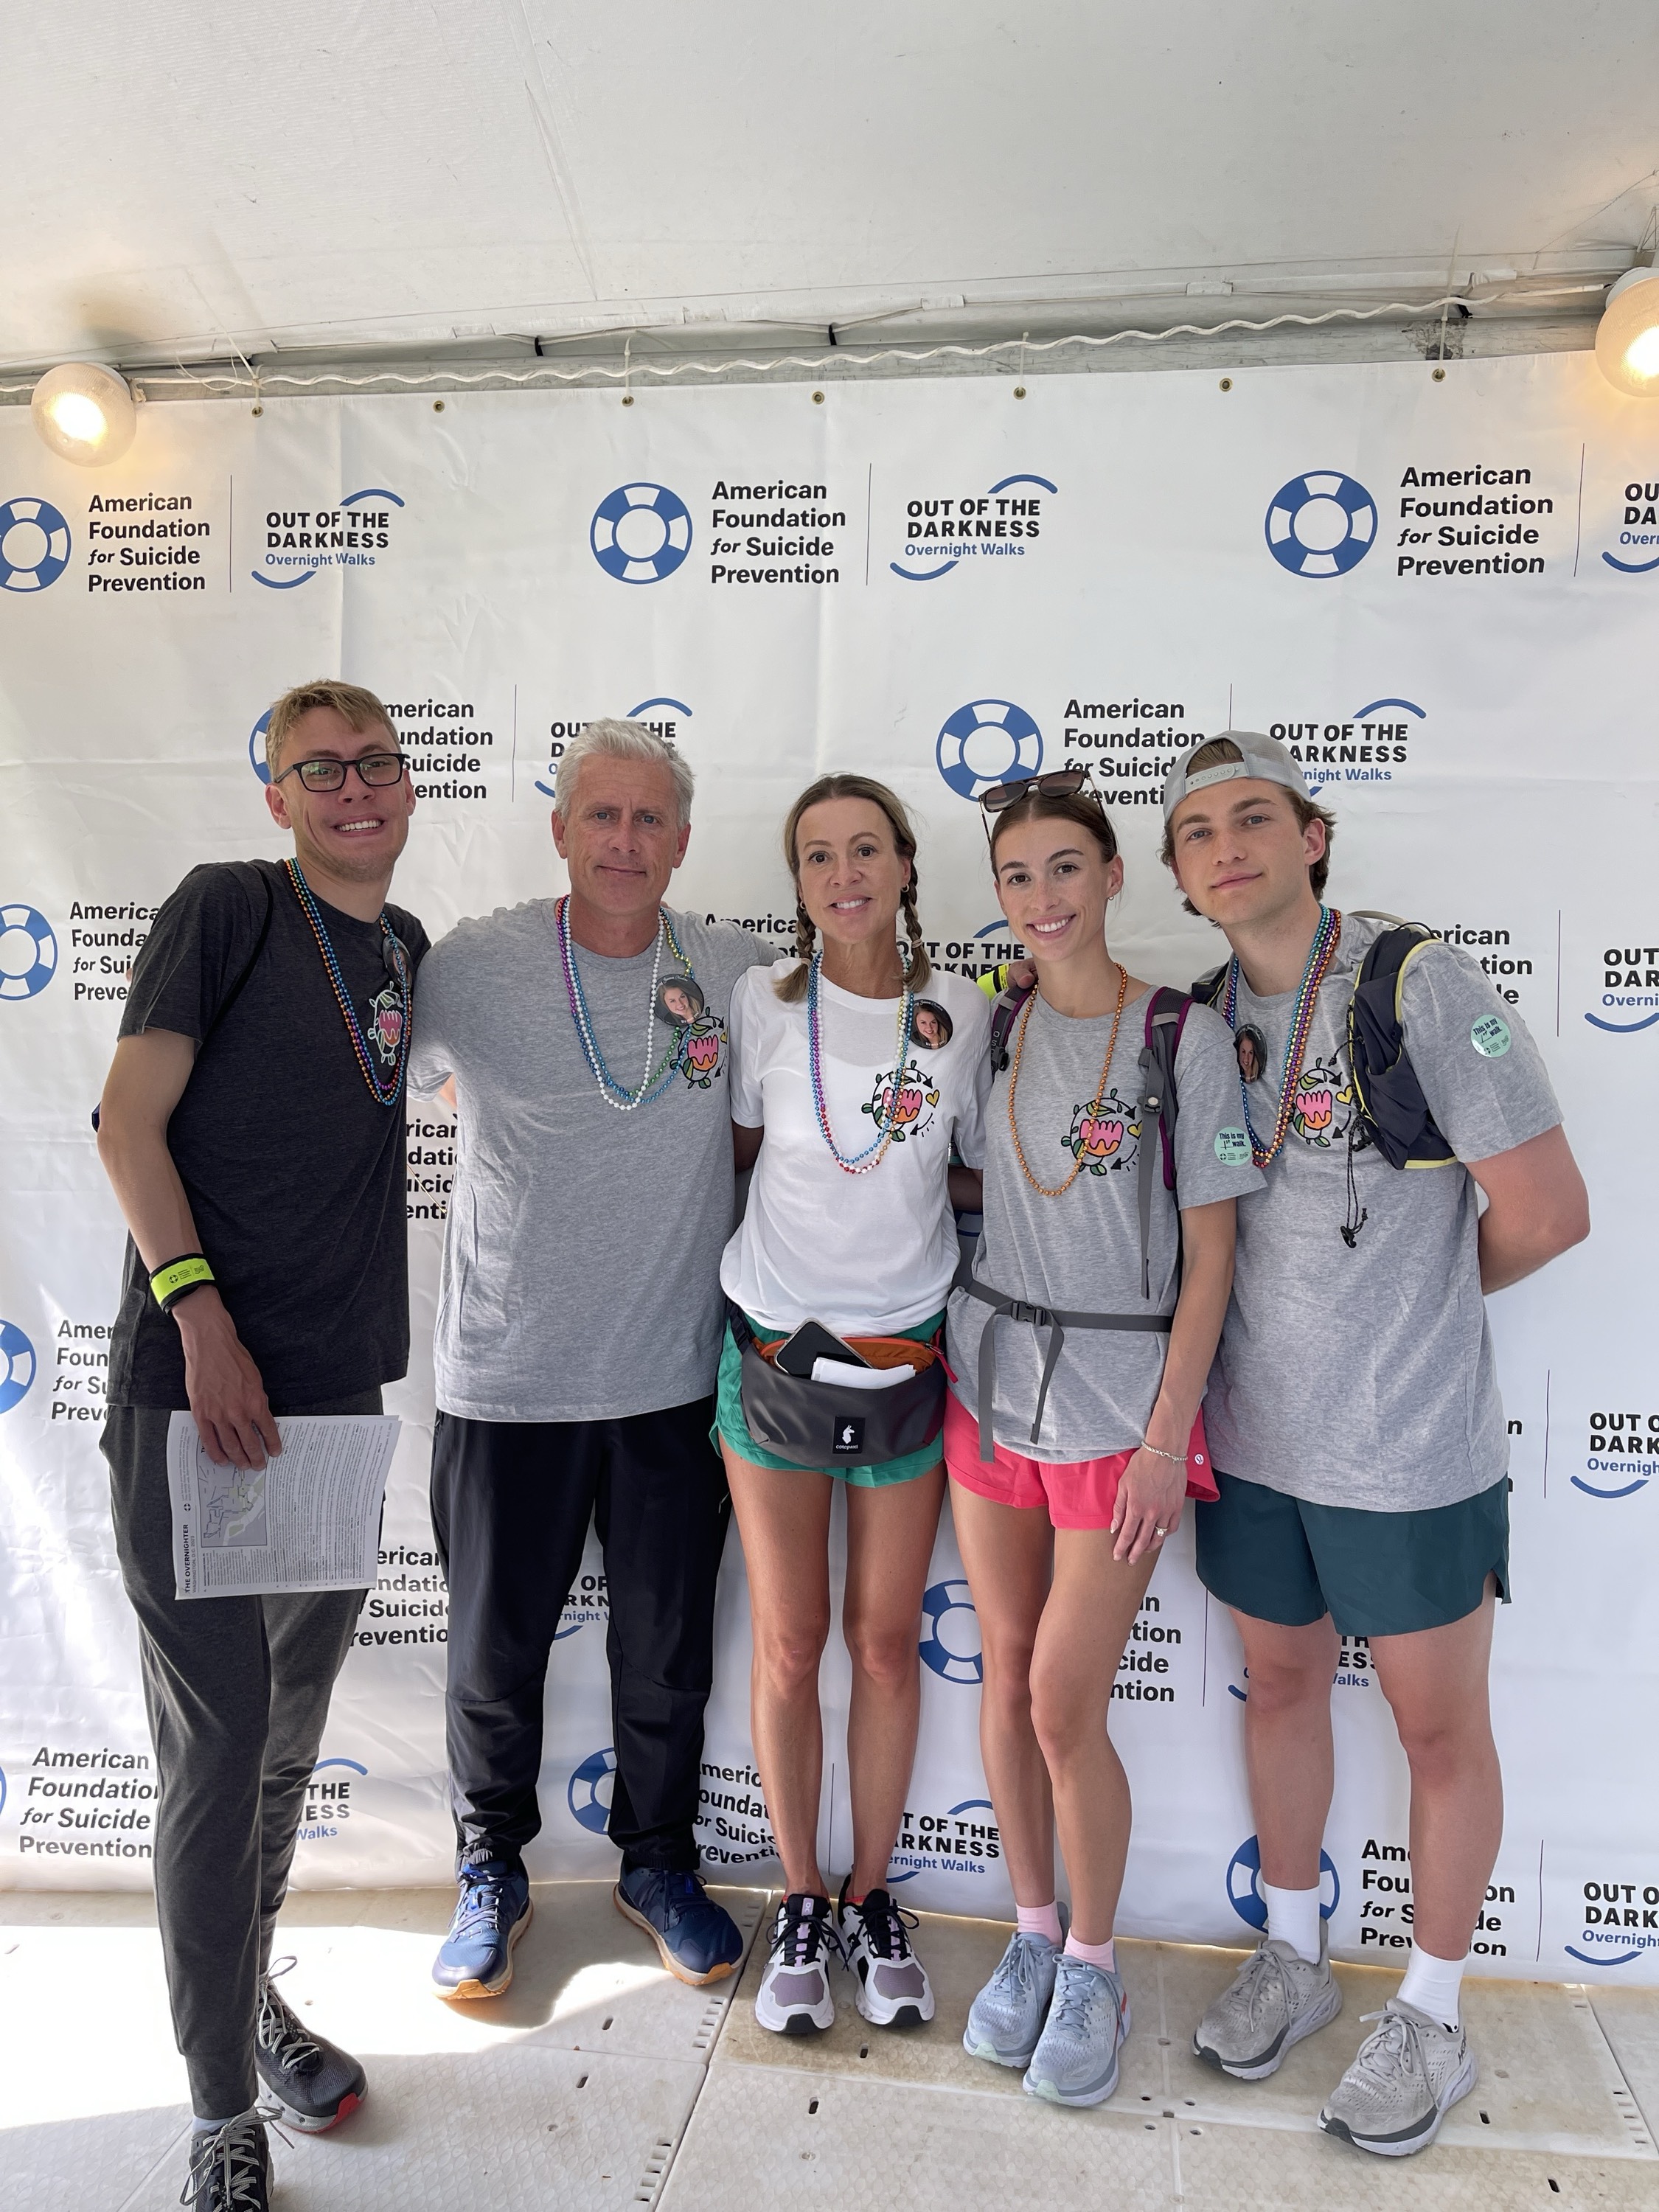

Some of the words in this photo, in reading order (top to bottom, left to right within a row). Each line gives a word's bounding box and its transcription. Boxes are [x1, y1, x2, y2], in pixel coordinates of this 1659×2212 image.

[1401, 465, 1531, 487] American
[712, 480, 827, 499] American
[1624, 483, 1659, 501] OU
[89, 493, 191, 512] American
[908, 500, 953, 517] OUT
[960, 499, 989, 515] OF
[996, 499, 1040, 515] THE
[1401, 494, 1553, 518] Foundation
[267, 512, 310, 528] OUT
[316, 512, 340, 528] OF
[347, 512, 389, 528] THE
[713, 508, 845, 528] Foundation
[90, 519, 209, 539] Foundation
[908, 521, 1039, 538] DARKNESS
[1397, 529, 1432, 546] for
[1438, 524, 1539, 546] Suicide
[268, 532, 388, 548] DARKNESS
[711, 538, 740, 555] for
[747, 536, 833, 556] Suicide
[88, 549, 114, 566] for
[120, 546, 200, 566] Suicide
[905, 543, 977, 557] Overnight
[981, 543, 1024, 555] Walks
[266, 554, 332, 568] Overnight
[335, 553, 375, 565] Walks
[1398, 552, 1544, 576] Prevention
[89, 572, 205, 591] Prevention
[712, 563, 838, 584] Prevention
[385, 698, 474, 717] merican
[1064, 698, 1184, 718] American
[399, 726, 493, 745] undation
[551, 722, 593, 738] OU
[640, 722, 676, 738] HE
[1270, 723, 1318, 740] OUT
[1324, 724, 1354, 741] OF
[1362, 724, 1408, 740] THE
[1290, 745, 1407, 762] ARKNESS
[1099, 756, 1177, 777] Suicid
[1302, 768, 1341, 783] night
[1346, 768, 1391, 780] Walks
[413, 780, 487, 799] ention
[72, 928, 147, 947] Founda
[1431, 924, 1510, 945] erican
[946, 942, 974, 959] OF
[981, 944, 1025, 959] THE
[73, 957, 96, 973] for
[74, 982, 130, 1001] Preve
[1602, 994, 1659, 1006] Overni
[58, 1320, 114, 1339] Amer
[53, 1376, 82, 1391] for
[1590, 1413, 1641, 1431] OUT
[1590, 1434, 1659, 1454] DARK
[1587, 1458, 1659, 1476] Overnigh
[378, 1545, 440, 1566] erica
[369, 1599, 448, 1618] Suicid
[559, 1610, 600, 1622] night
[350, 1624, 448, 1646] reventio
[1118, 1649, 1169, 1673] cide
[1333, 1673, 1369, 1687] alks
[1110, 1680, 1174, 1702] ntion
[32, 1747, 148, 1769] American
[700, 1763, 762, 1787] meric
[28, 1776, 159, 1800] Foundatio
[20, 1807, 53, 1825] for
[58, 1808, 150, 1829] Suicide
[695, 1815, 712, 1827] or
[715, 1817, 776, 1844] Suici
[919, 1816, 948, 1832] OF
[955, 1821, 999, 1840] THE
[19, 1835, 152, 1858] Prevention
[698, 1844, 780, 1864] reventi
[894, 1833, 999, 1858] RKNESS
[888, 1855, 937, 1869] ernight
[941, 1858, 985, 1873] Walks
[1584, 1882, 1635, 1903] OUT
[1360, 1901, 1395, 1917] for
[1585, 1906, 1658, 1928] DARK
[1582, 1930, 1659, 1948] Overnigh
